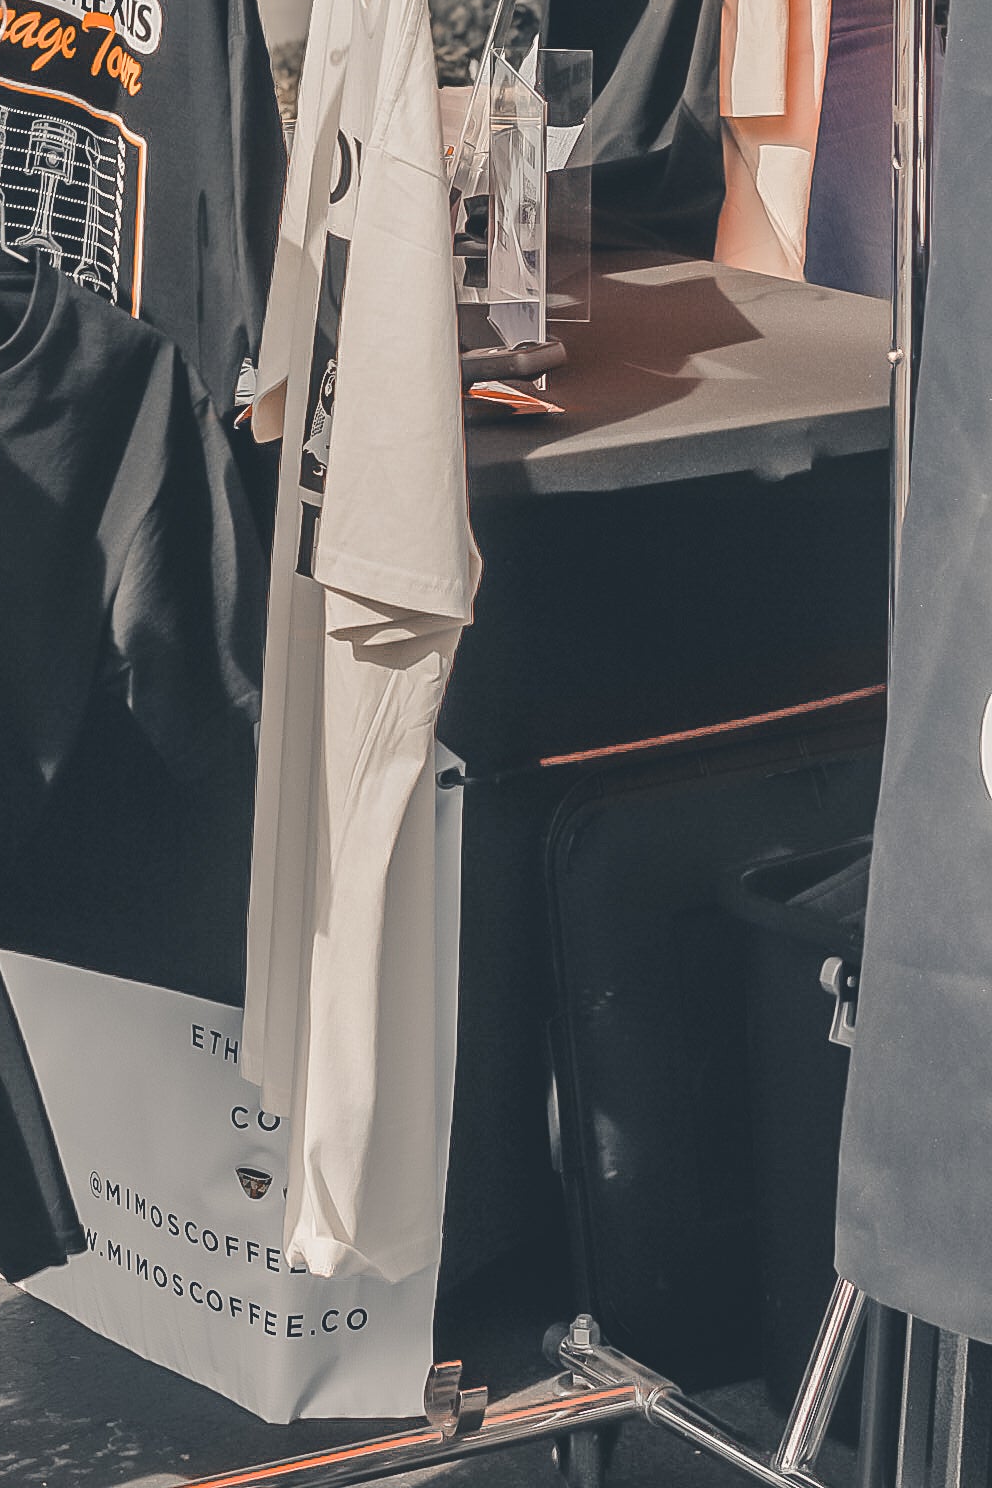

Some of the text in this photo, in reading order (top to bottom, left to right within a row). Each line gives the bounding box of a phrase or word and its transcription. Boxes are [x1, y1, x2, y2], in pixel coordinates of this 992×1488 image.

[82, 11, 144, 97] Tour
[191, 1023, 239, 1064] ETH
[231, 1106, 281, 1132] CO
[90, 1170, 307, 1274] @MIMOSCOFFE
